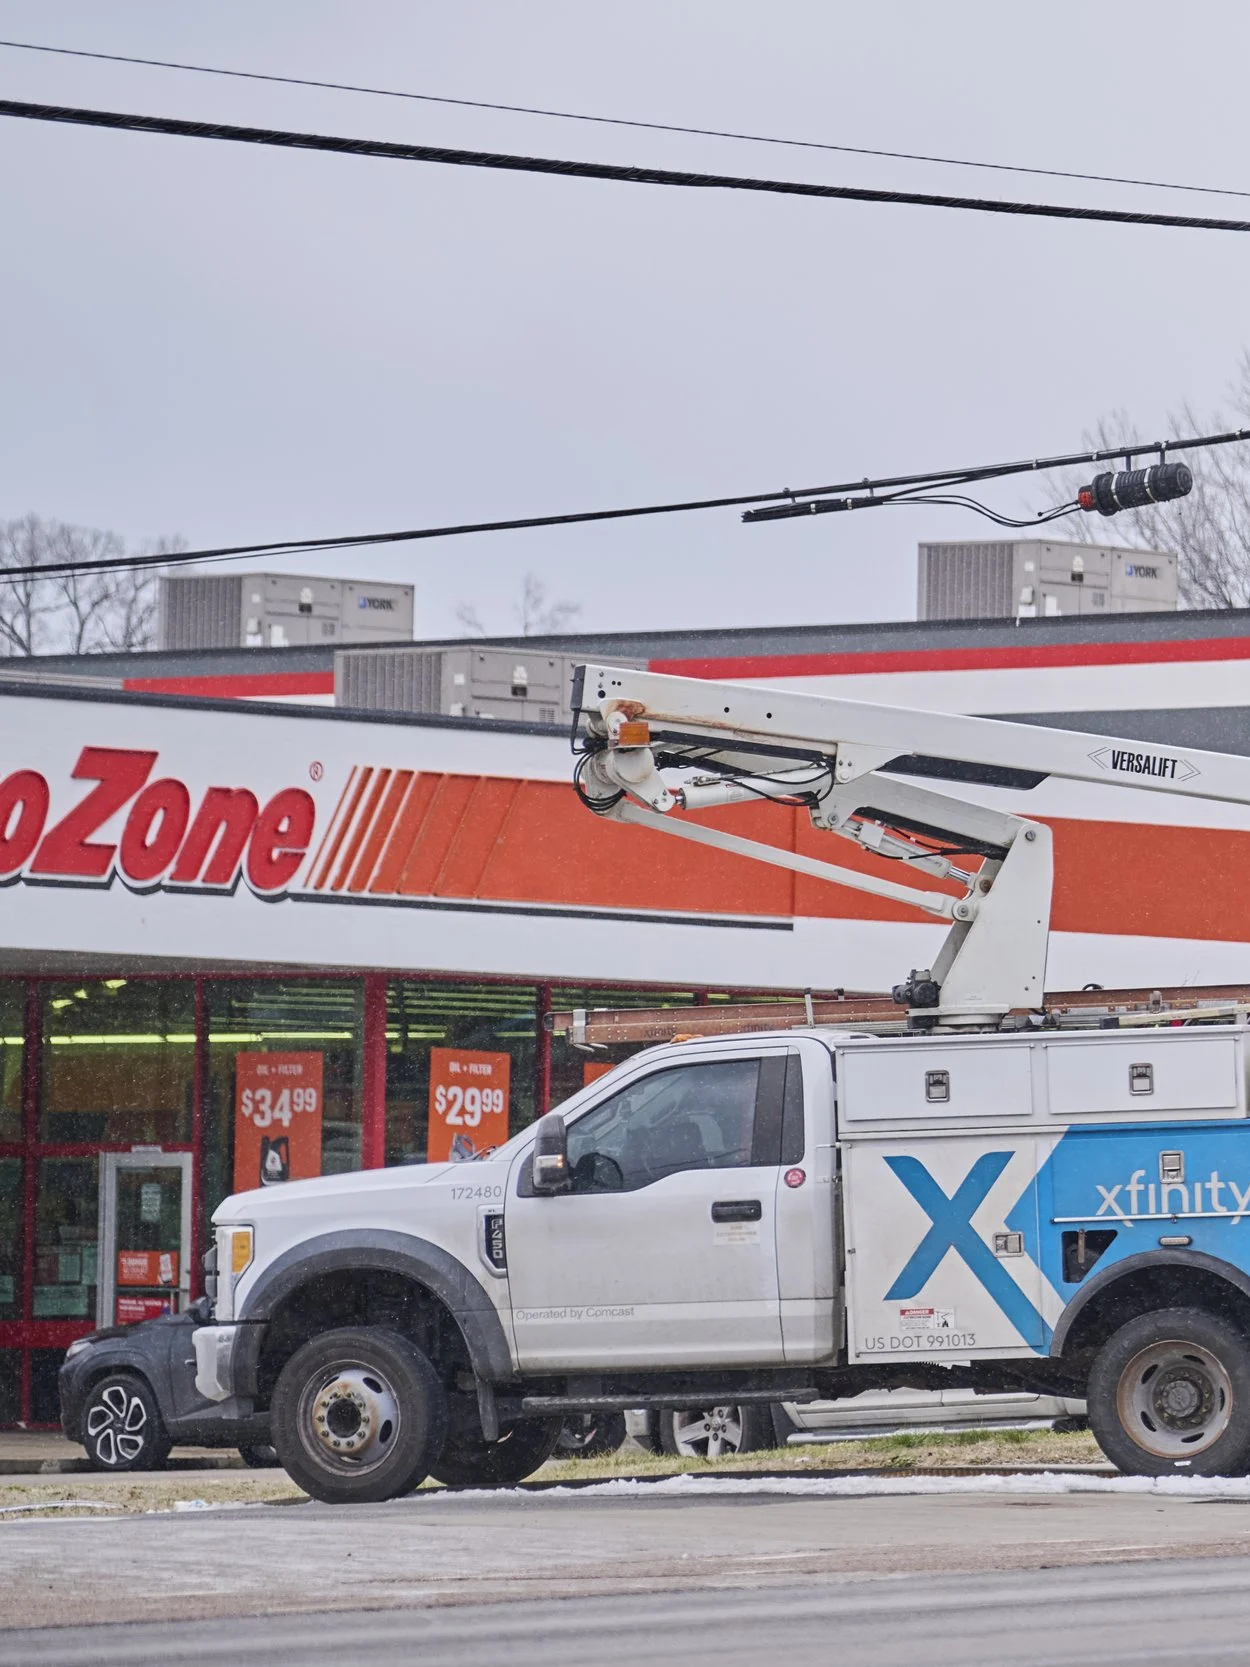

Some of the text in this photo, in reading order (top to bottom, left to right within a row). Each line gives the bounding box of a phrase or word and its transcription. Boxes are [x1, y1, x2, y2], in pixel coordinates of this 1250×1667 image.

[1134, 565, 1157, 578] YORK
[367, 598, 392, 609] YORK
[1111, 749, 1178, 779] VERSALIFT
[469, 1063, 492, 1075] FILTER
[451, 1185, 502, 1200] 172480
[516, 1306, 635, 1320] Operated by Comcast
[865, 1333, 976, 1350] US DOT 991013
